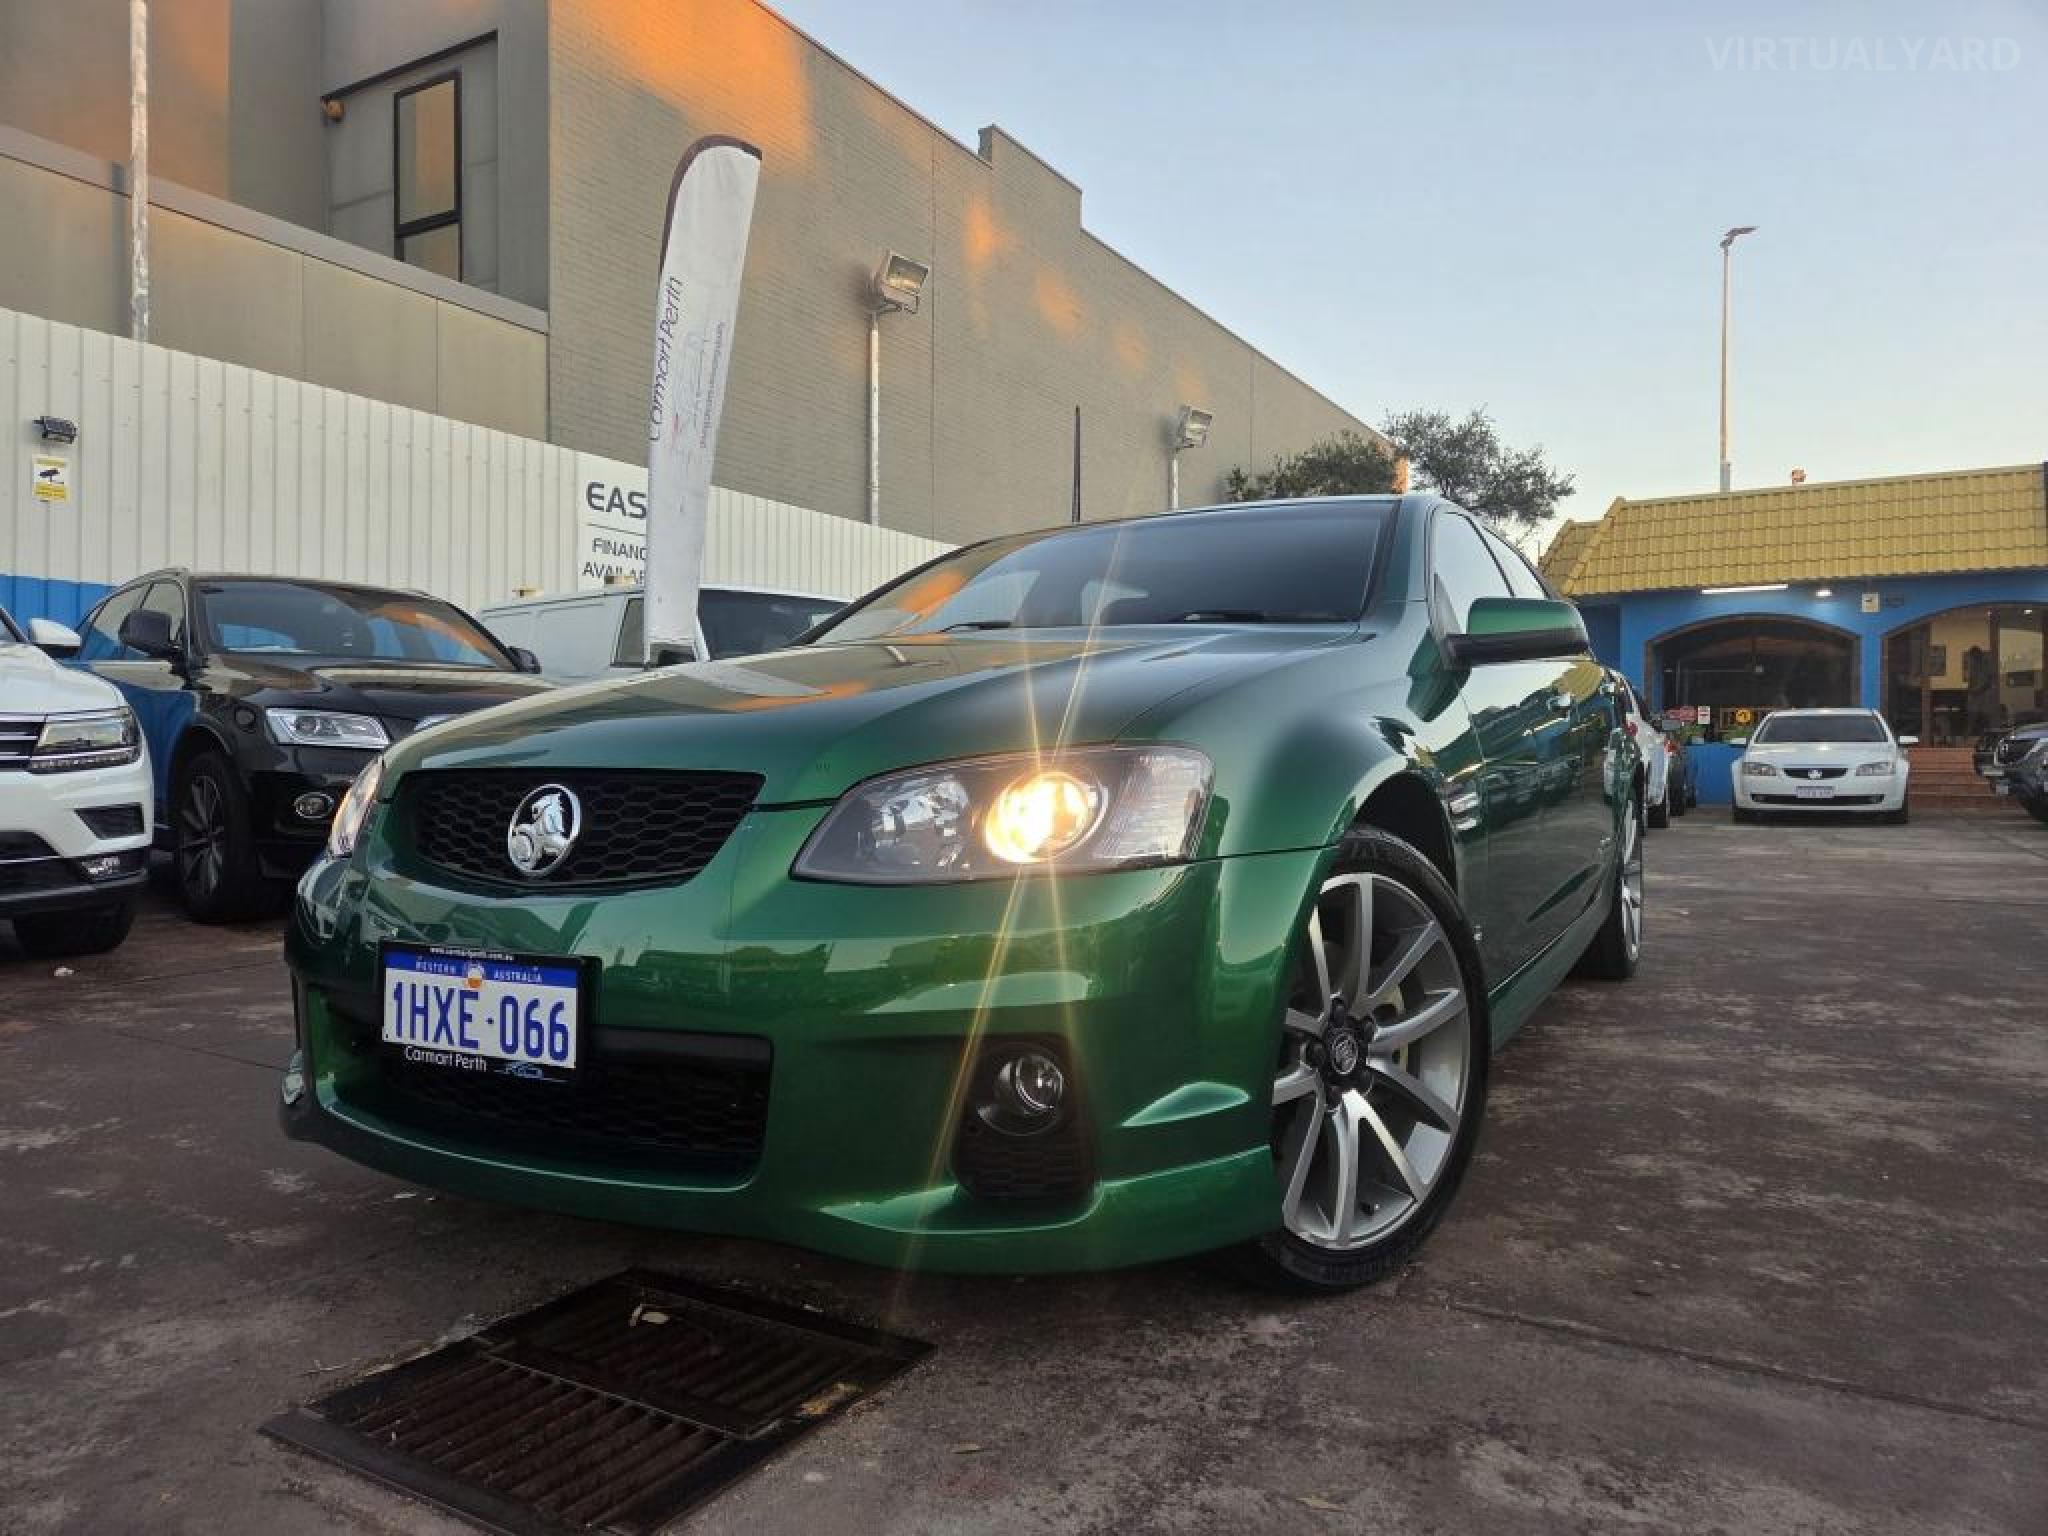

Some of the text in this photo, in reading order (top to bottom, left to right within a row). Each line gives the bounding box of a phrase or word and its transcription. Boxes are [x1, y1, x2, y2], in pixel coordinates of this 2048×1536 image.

[658, 276, 683, 338] Perth
[586, 481, 647, 519] EAS
[493, 969, 543, 984] AUSTRALIA
[455, 1052, 487, 1072] Perth
